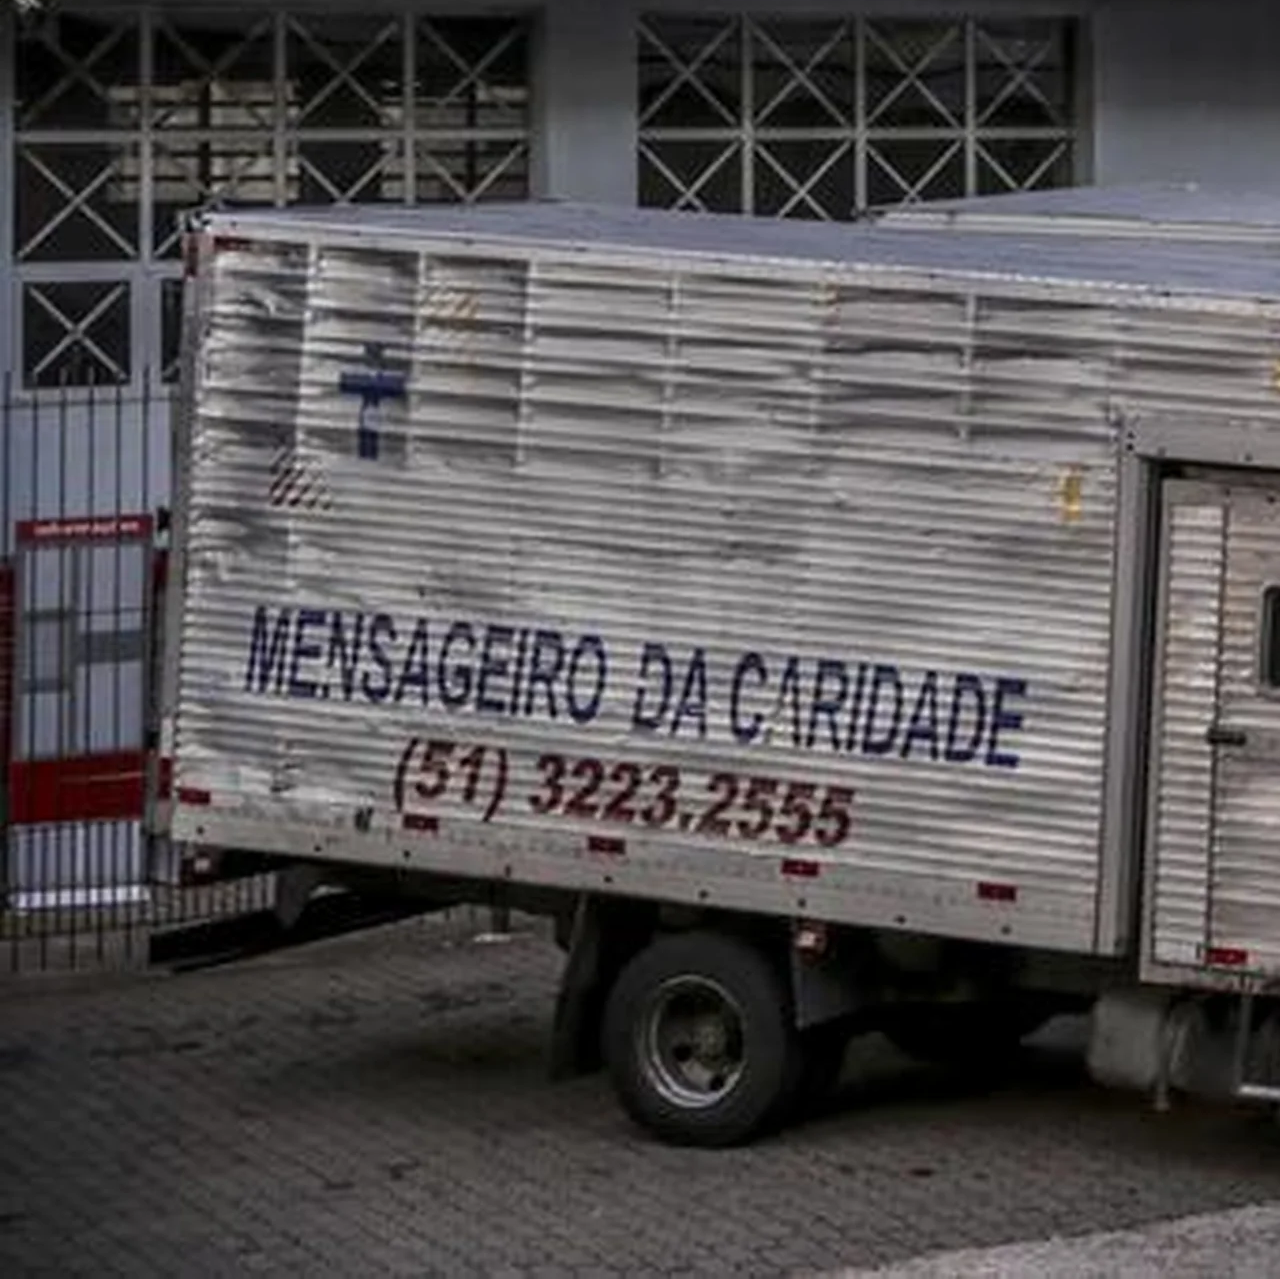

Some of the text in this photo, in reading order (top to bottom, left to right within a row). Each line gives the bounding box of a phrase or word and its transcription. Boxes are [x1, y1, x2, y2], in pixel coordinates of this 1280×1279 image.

[245, 606, 1028, 768] MENSAGEIRO DA CARIDADE
[394, 738, 856, 847] (51) 3223.2555
